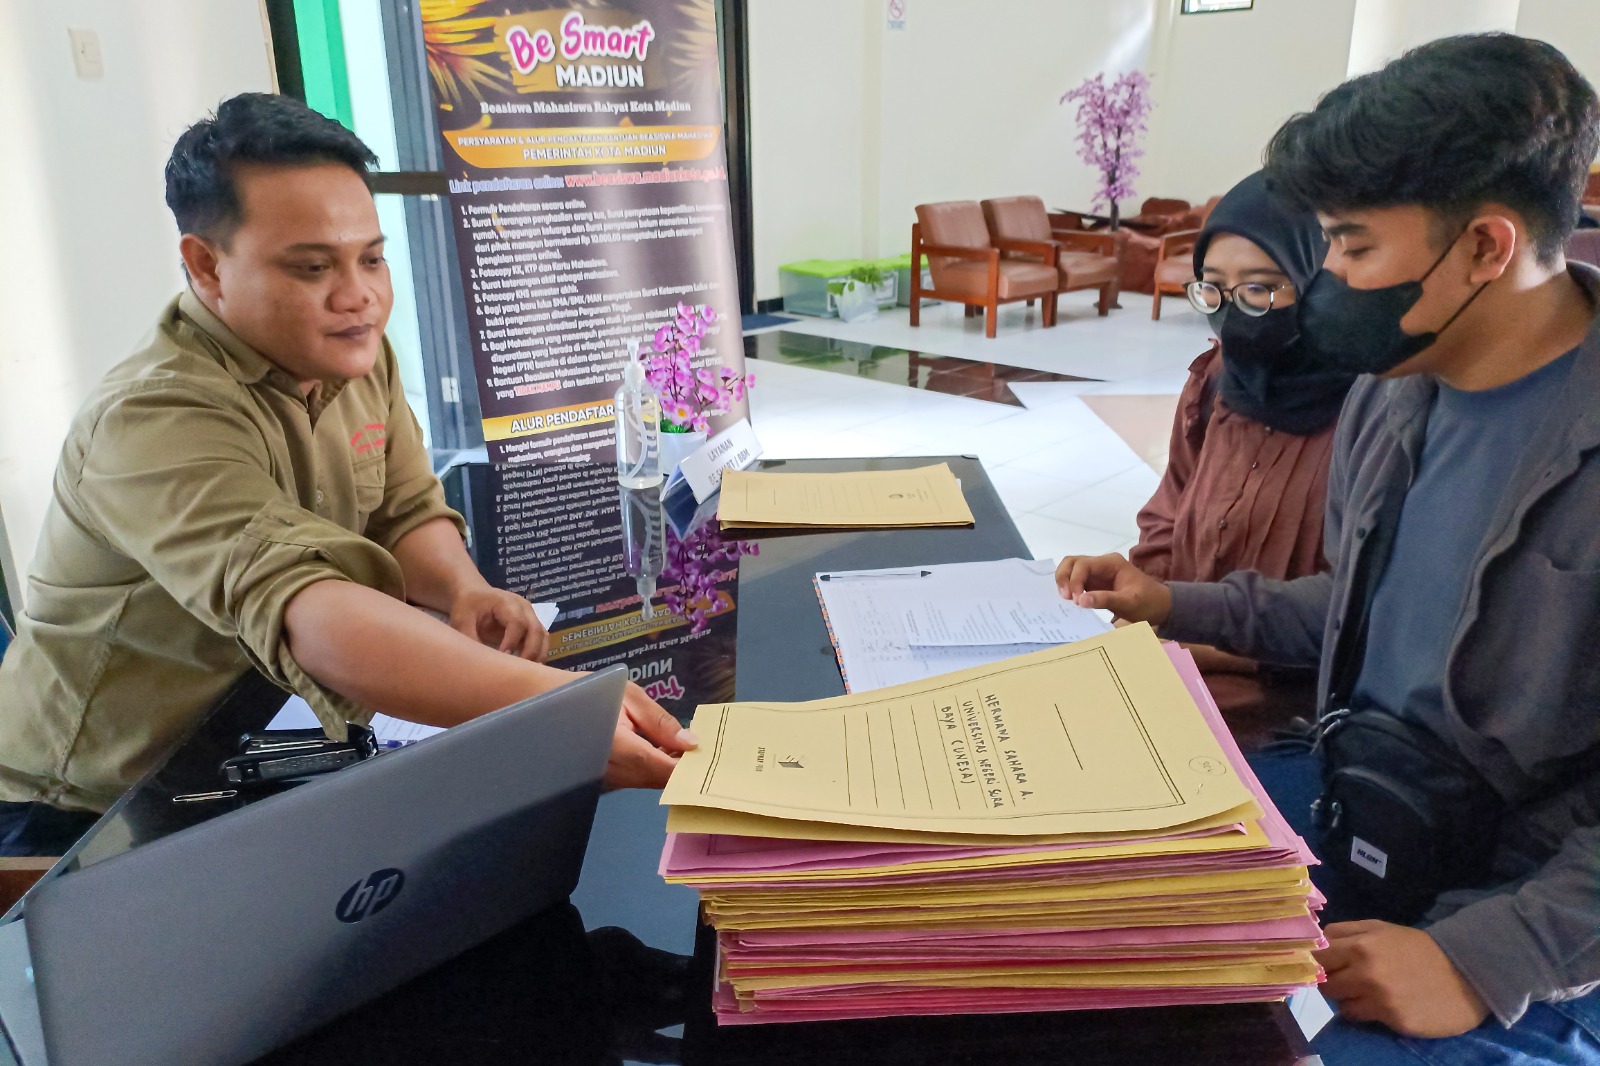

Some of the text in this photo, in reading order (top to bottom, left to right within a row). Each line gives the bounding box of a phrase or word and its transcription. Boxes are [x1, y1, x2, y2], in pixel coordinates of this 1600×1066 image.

[507, 14, 653, 72] Be Smart
[556, 64, 644, 87] MADIUN
[480, 100, 691, 115] Beasiswa Mahasiswa Rakyat Kota Madiun
[458, 136, 516, 147] PERSYARATAN
[526, 136, 545, 145] ALUR
[523, 145, 667, 160] PEMERINTAH KOTA MADIUN
[511, 404, 615, 433] ALUR PENDAFTAR
[708, 438, 733, 462] LAYANAN
[737, 448, 750, 463] BBM
[939, 706, 976, 784] BAYA (UNESA)
[962, 700, 1004, 808] UNIVERSITAS NEGERI SURA
[985, 693, 1034, 800] HERMANA SAHARA A.
[340, 871, 401, 920] hp
